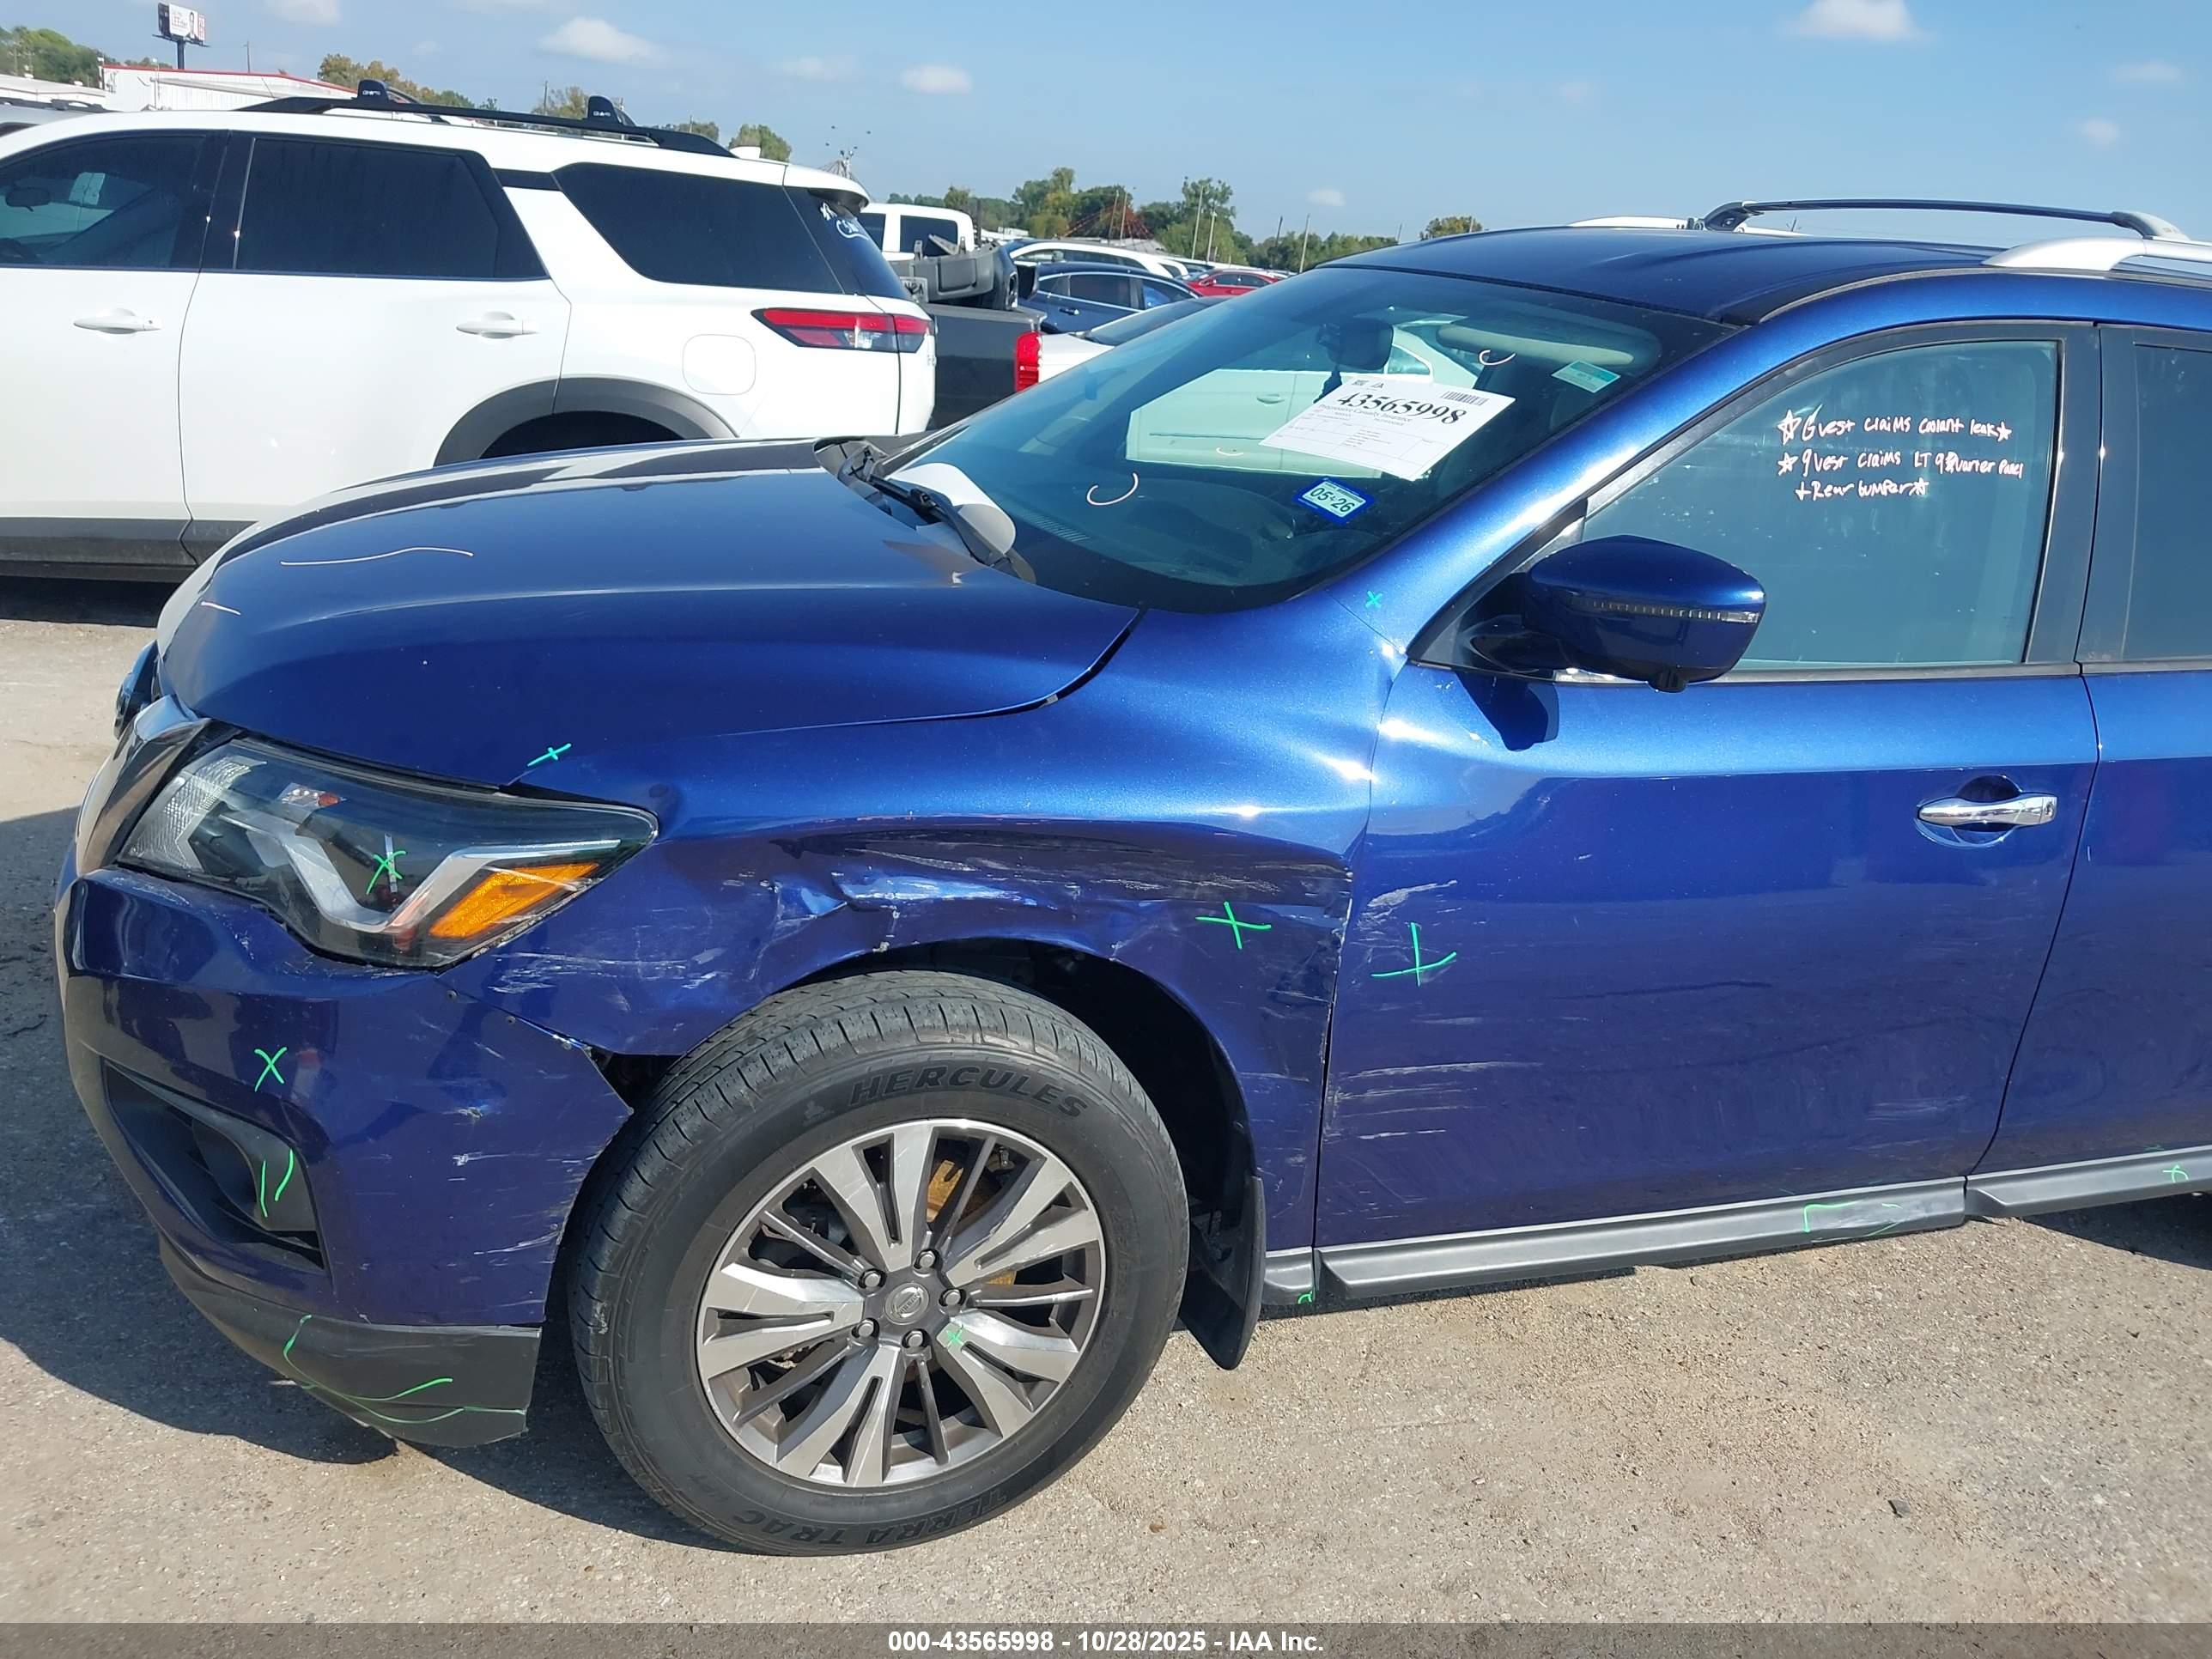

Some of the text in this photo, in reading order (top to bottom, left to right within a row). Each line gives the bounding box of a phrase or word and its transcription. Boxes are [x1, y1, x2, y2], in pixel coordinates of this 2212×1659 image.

[1336, 392, 1468, 425] 43565998
[1914, 451, 1932, 468] LT
[1310, 487, 1355, 513] 05 26
[848, 1065, 1088, 1118] HERCULES
[733, 1489, 1008, 1545] TERRA TRAC
